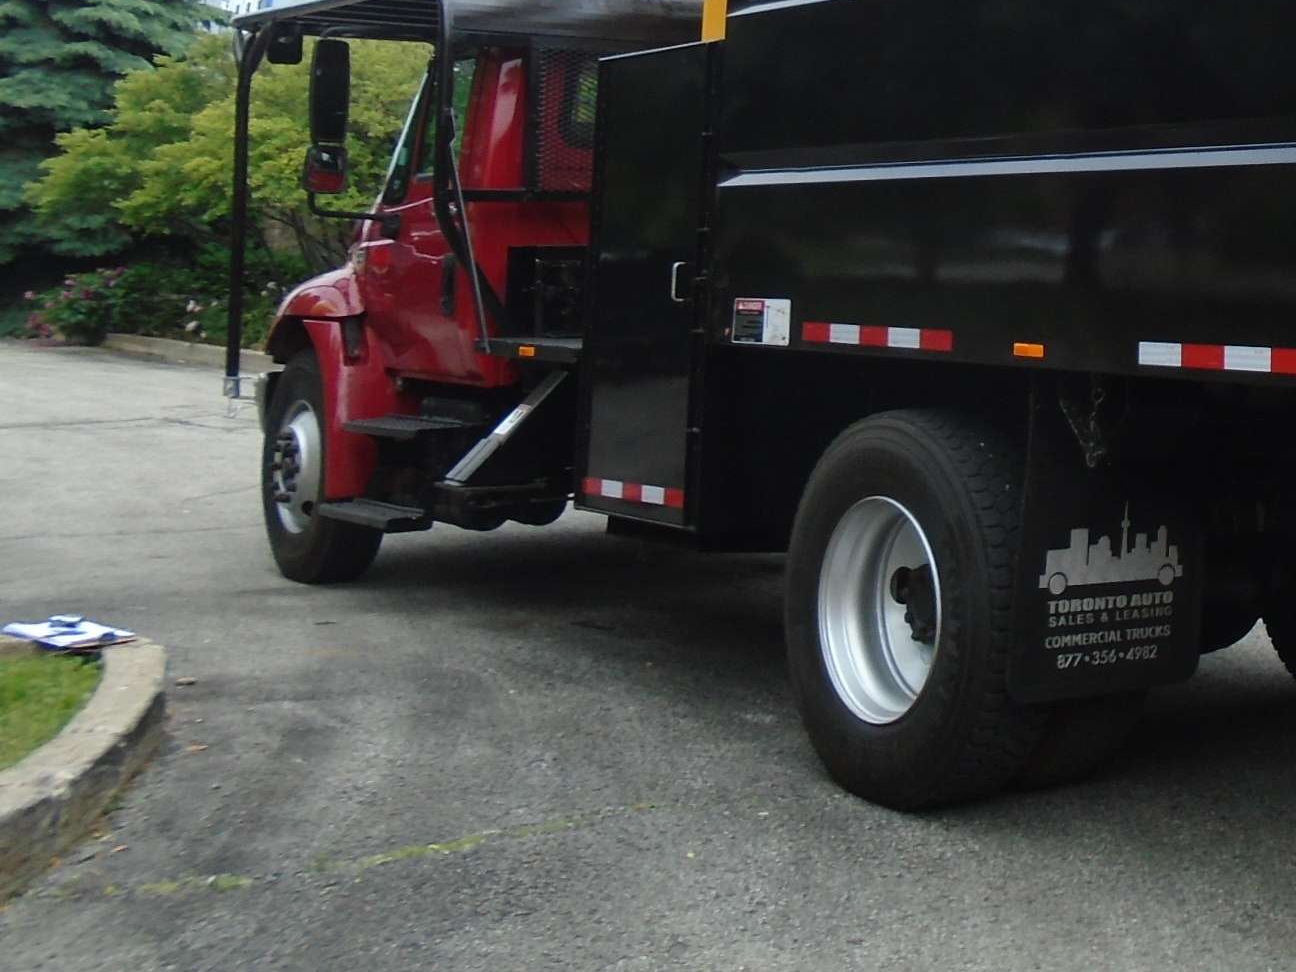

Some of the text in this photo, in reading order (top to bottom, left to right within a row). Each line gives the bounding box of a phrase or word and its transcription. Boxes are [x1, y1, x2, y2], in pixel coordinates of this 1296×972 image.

[1047, 591, 1173, 614] TORONTO AUTO
[1048, 605, 1173, 628] SALES & LEASING
[1045, 625, 1171, 649] COMMERCIAL TRUCKS
